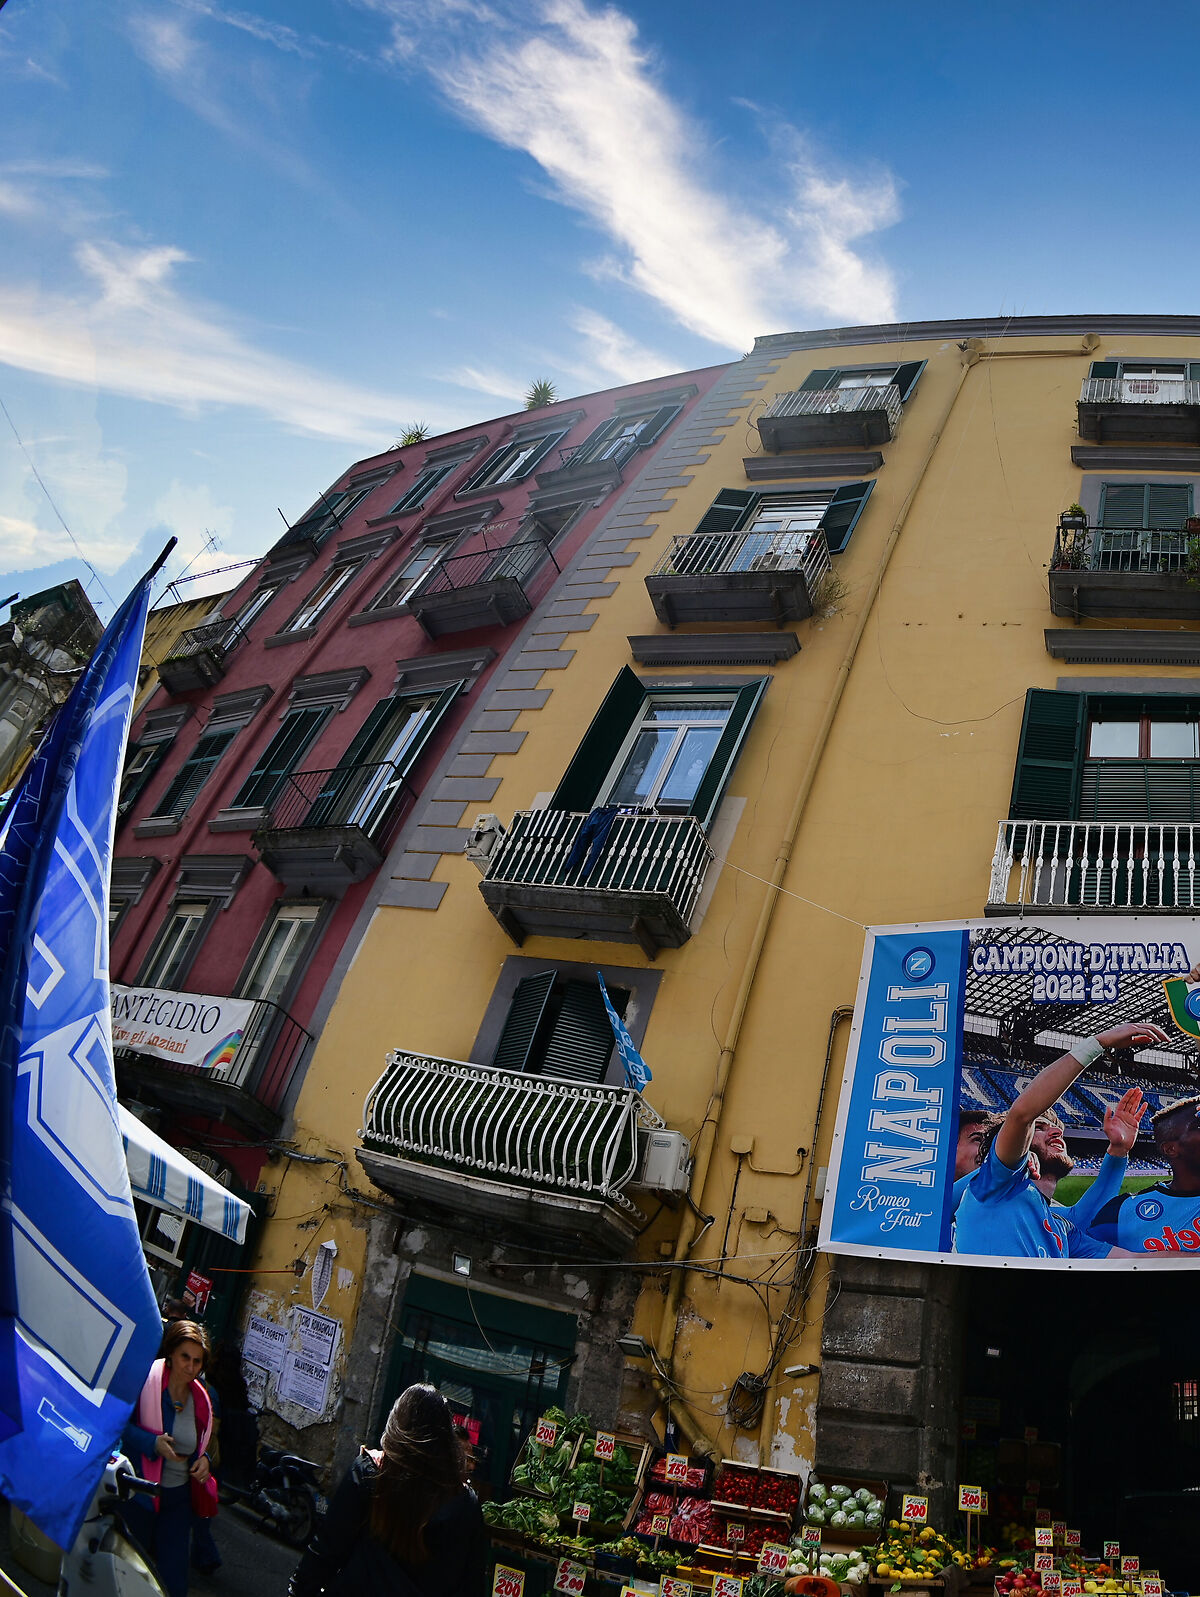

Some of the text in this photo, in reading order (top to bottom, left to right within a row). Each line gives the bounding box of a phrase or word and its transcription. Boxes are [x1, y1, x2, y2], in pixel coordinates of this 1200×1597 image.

[971, 943, 1190, 973] CAMPIONI D'ITALIA
[1033, 973, 1119, 1002] 2022-23
[111, 992, 221, 1034] ANT'EGIDIO
[860, 982, 950, 1188] NAPOLI
[849, 1184, 911, 1212] Romeo
[880, 1207, 933, 1232] Fruit
[537, 1427, 555, 1441] 200
[596, 1440, 614, 1454] 200
[495, 1578, 521, 1597] 200
[1044, 1576, 1060, 1587] 200
